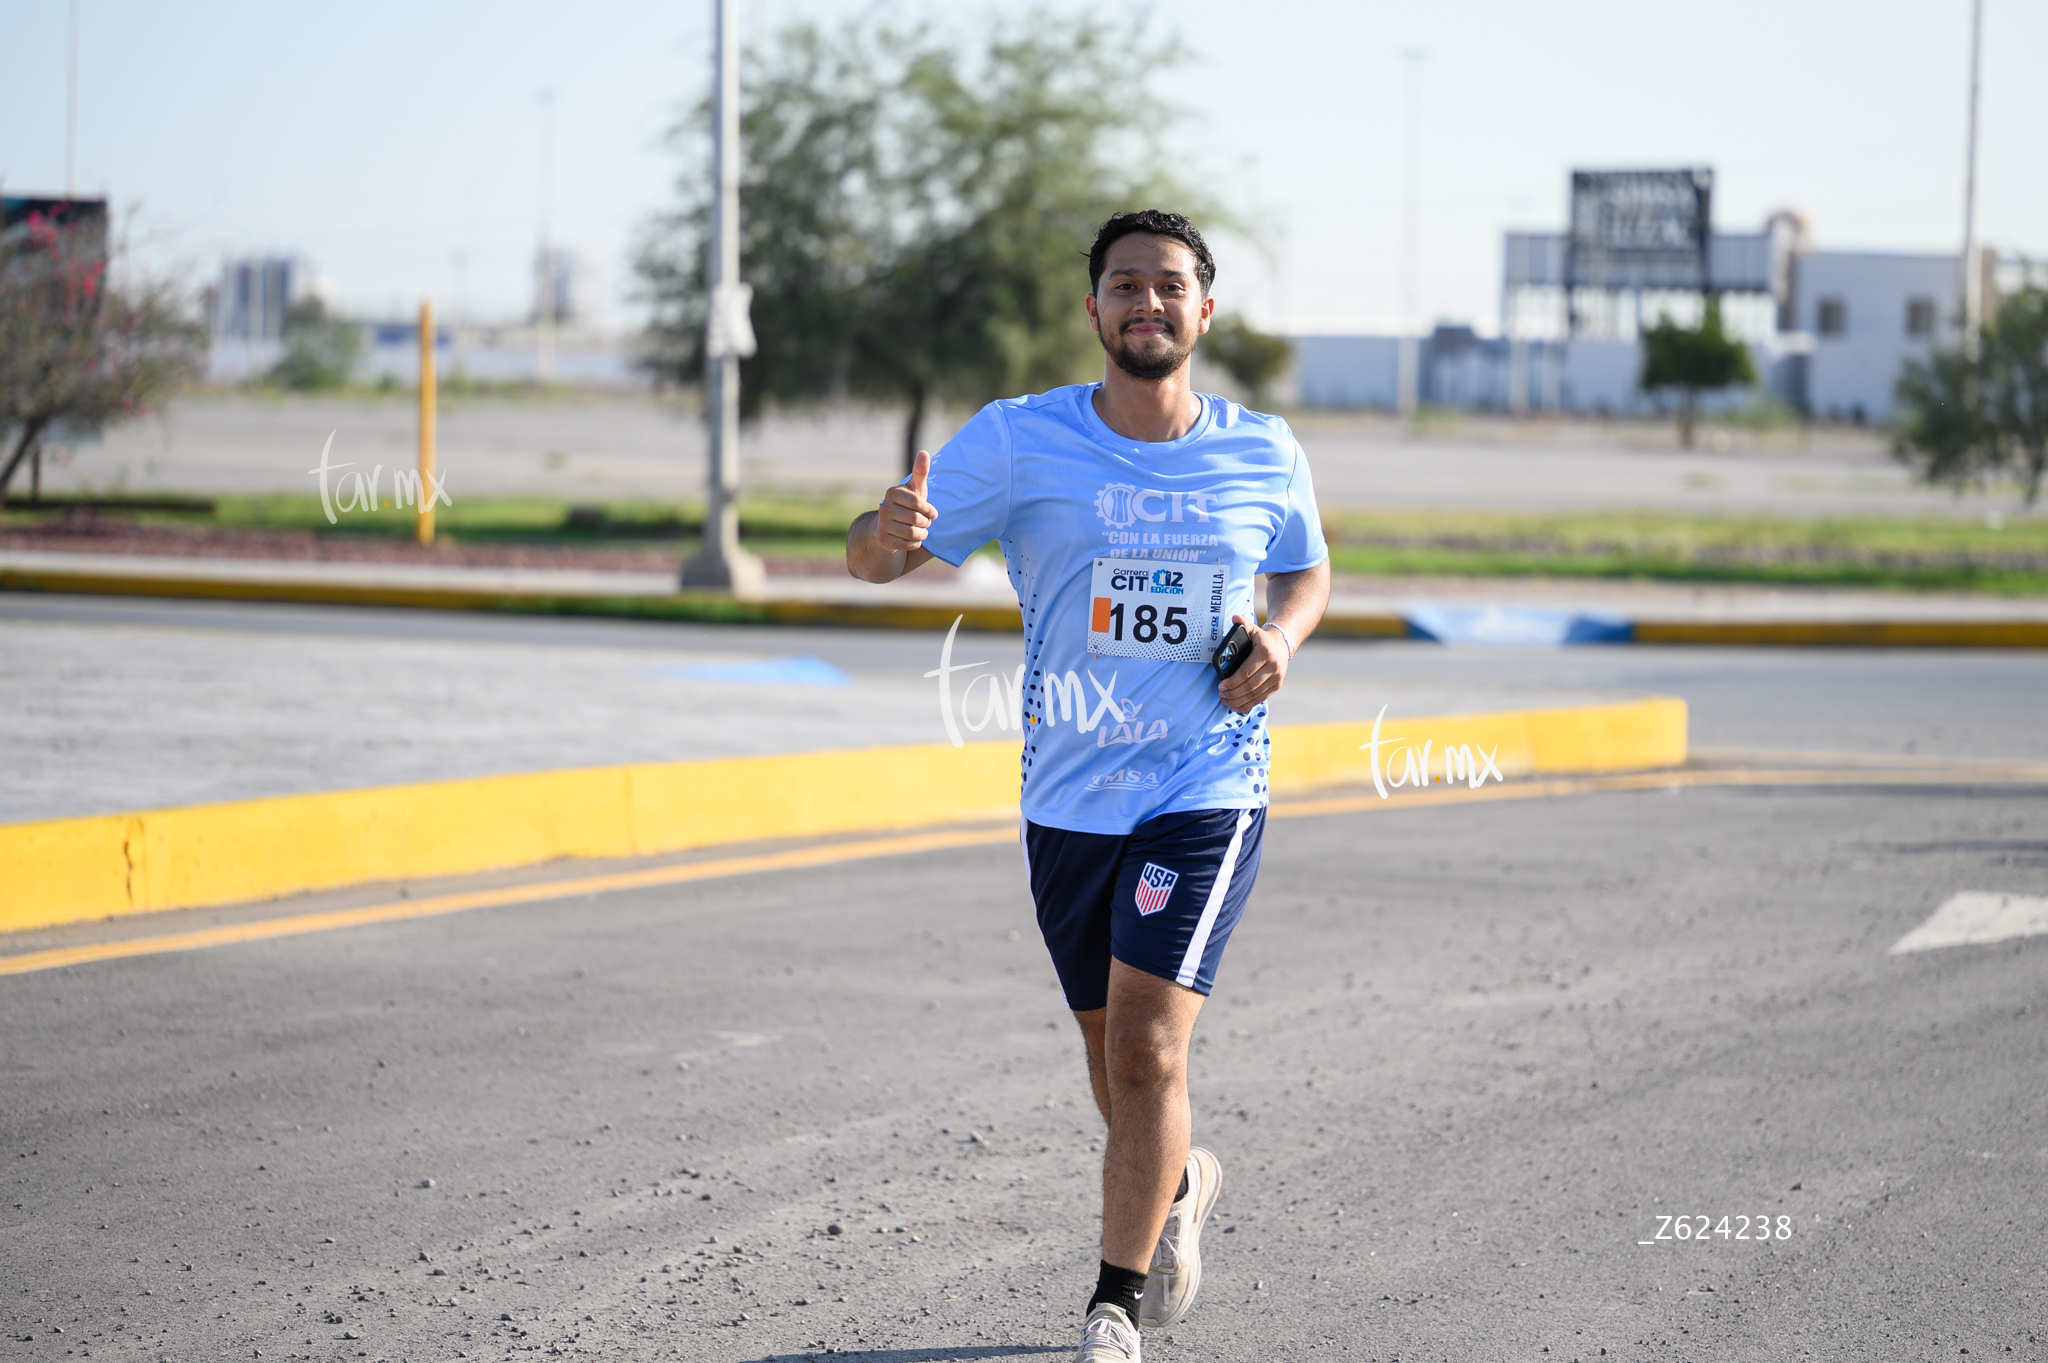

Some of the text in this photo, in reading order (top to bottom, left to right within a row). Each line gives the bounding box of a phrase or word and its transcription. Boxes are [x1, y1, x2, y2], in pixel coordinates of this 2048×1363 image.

[1131, 490, 1218, 523] CIT
[1142, 532, 1160, 545] LA
[1163, 533, 1219, 547] FUERZA
[1110, 548, 1128, 559] DE
[1131, 548, 1149, 559] LA
[1110, 575, 1149, 591] CIT
[1113, 568, 1148, 576] Carrera
[1210, 573, 1225, 613] MEDALLA
[1109, 602, 1188, 645] 185
[1097, 718, 1169, 749] LALA
[1143, 864, 1177, 888] USA
